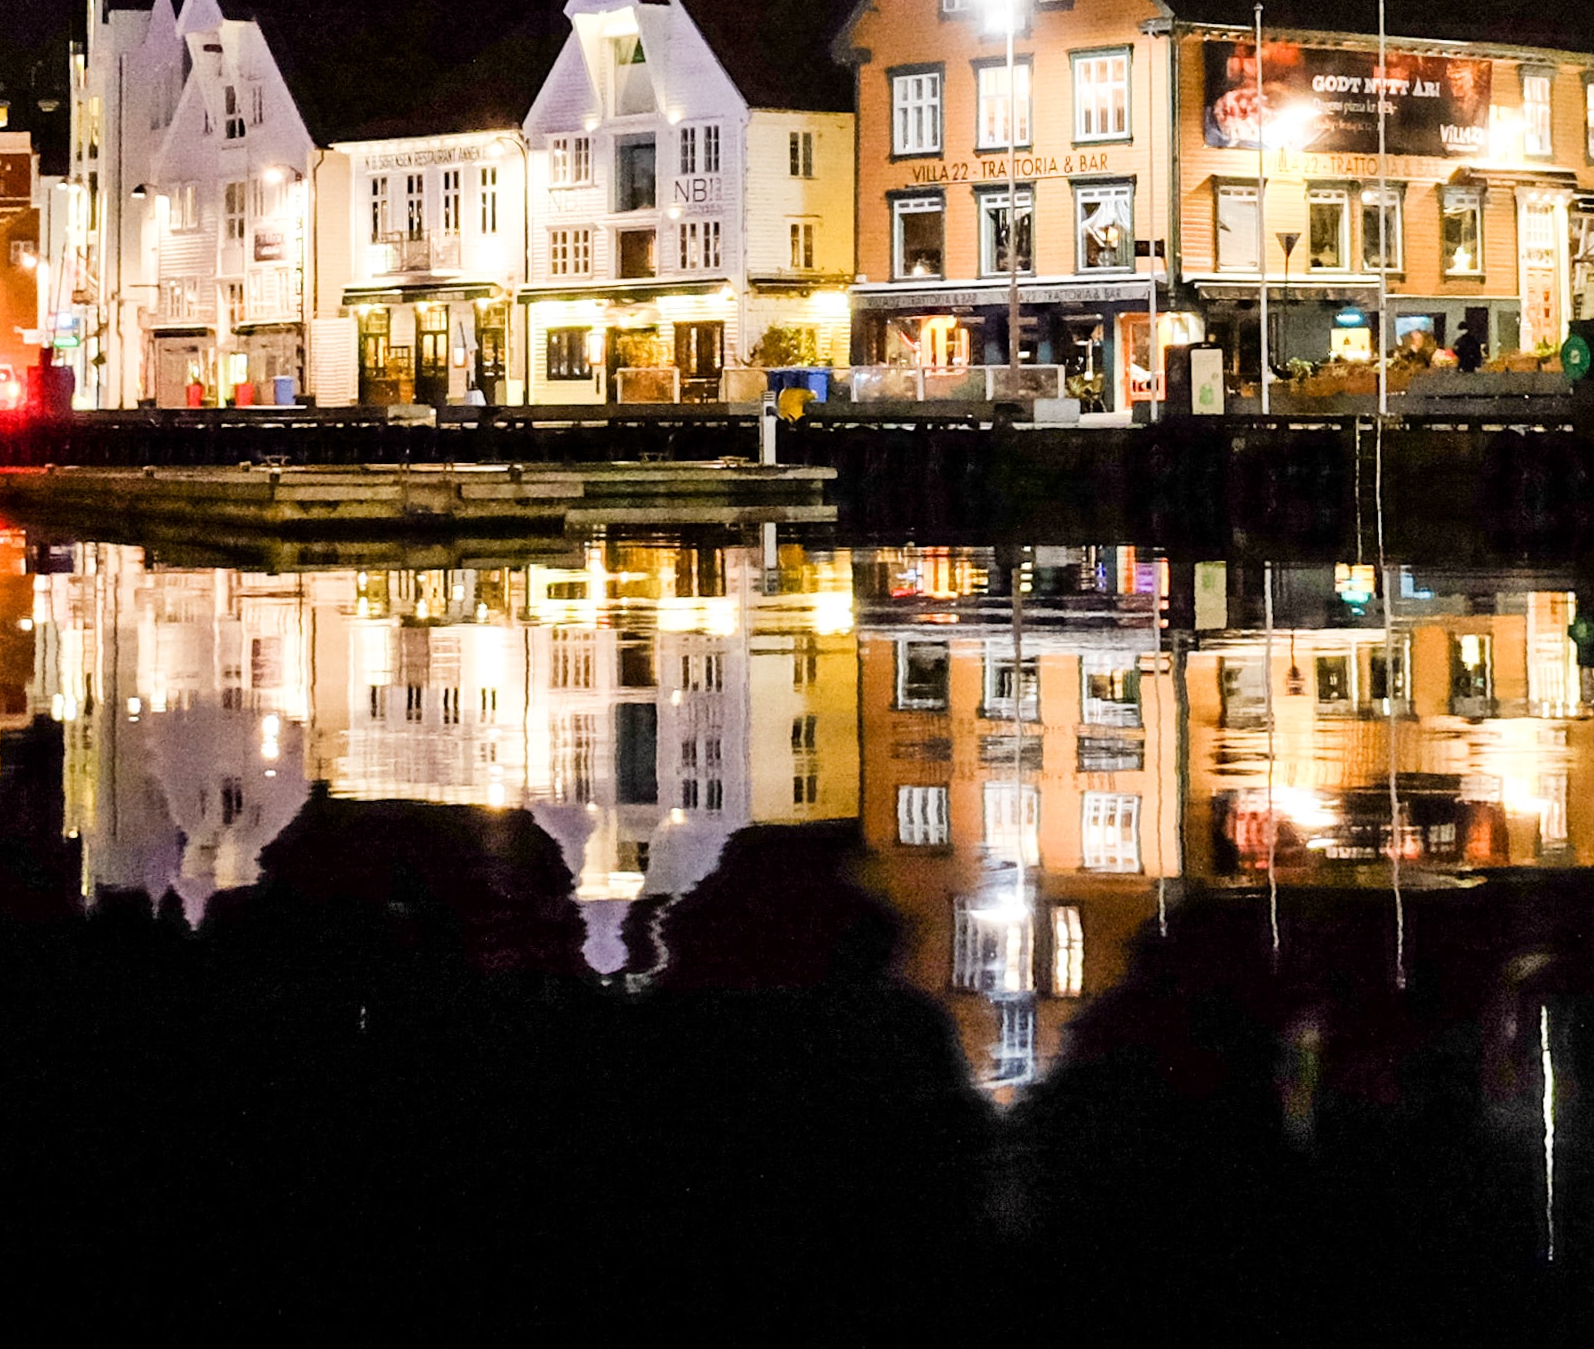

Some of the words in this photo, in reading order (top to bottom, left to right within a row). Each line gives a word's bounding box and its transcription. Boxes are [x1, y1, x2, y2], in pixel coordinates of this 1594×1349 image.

[1312, 75, 1362, 93] GODT
[913, 166, 948, 183] VILLA
[952, 163, 968, 180] 22
[981, 158, 1057, 179] TRATORIA
[1064, 155, 1074, 173] &
[1079, 153, 1108, 172] BAR
